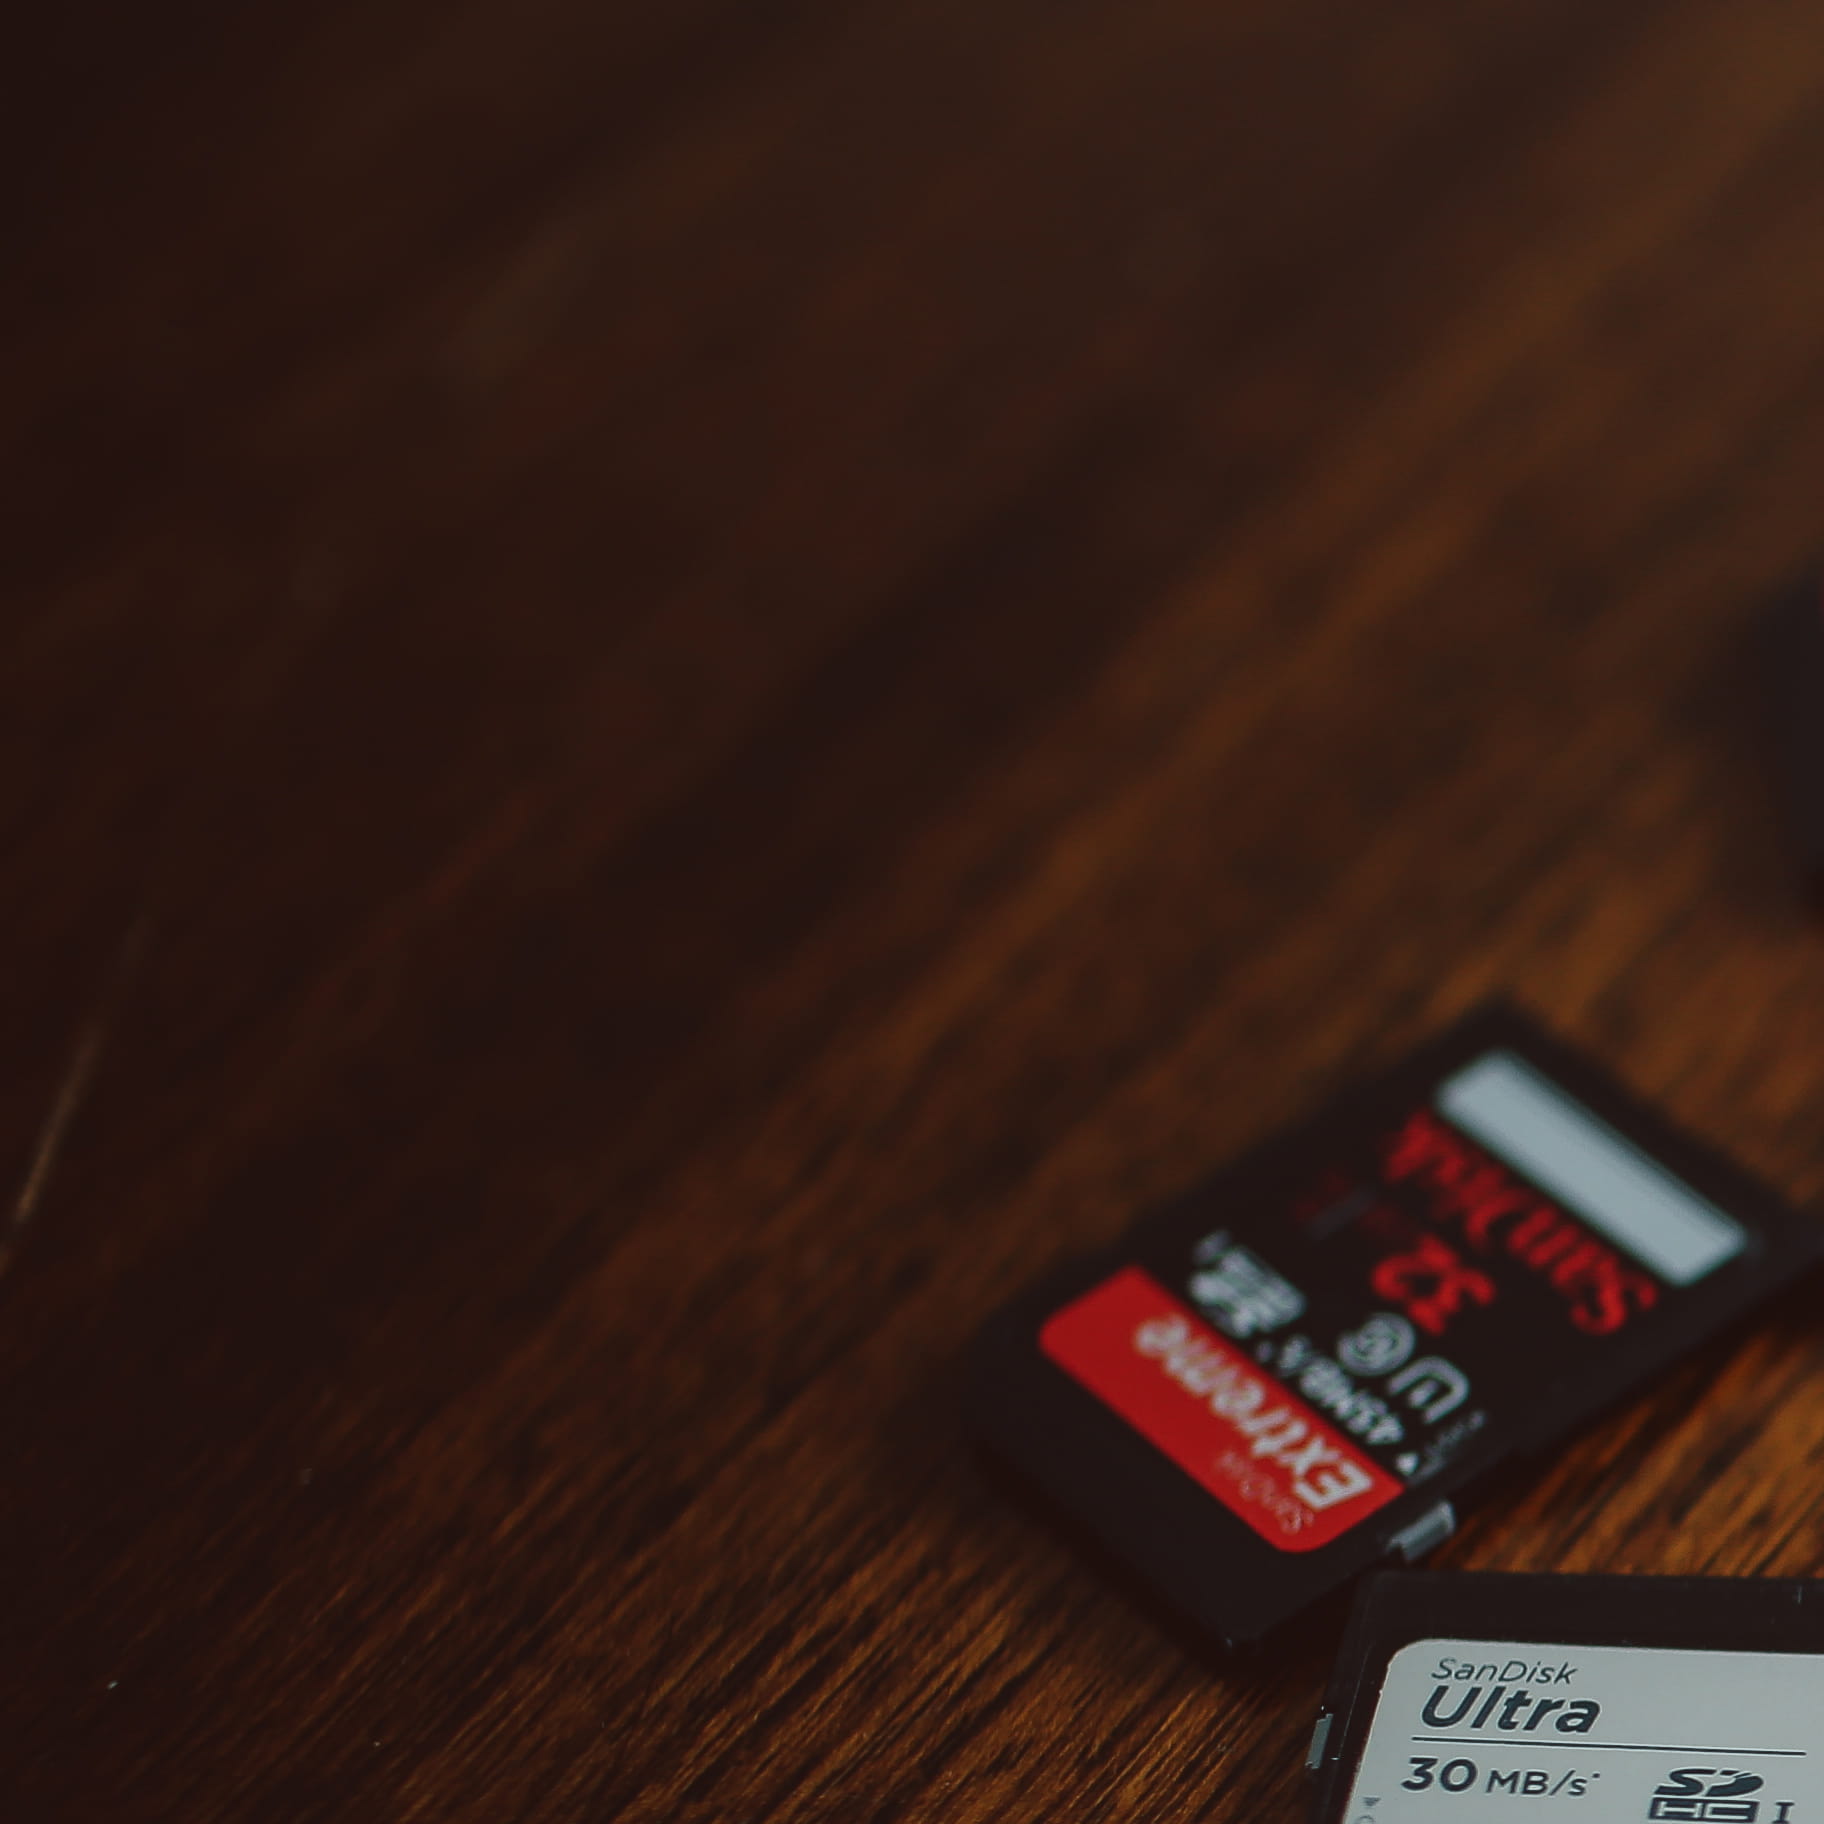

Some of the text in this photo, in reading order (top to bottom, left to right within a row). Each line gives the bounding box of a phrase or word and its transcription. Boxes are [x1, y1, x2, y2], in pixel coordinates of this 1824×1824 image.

[1385, 1108, 1657, 1337] SanDisk
[1372, 1233, 1495, 1335] 32
[1134, 1311, 1373, 1511] Extreme
[1419, 1684, 1602, 1734] Ultra
[1430, 1657, 1577, 1686] SanDisk
[1400, 1756, 1478, 1794] 30
